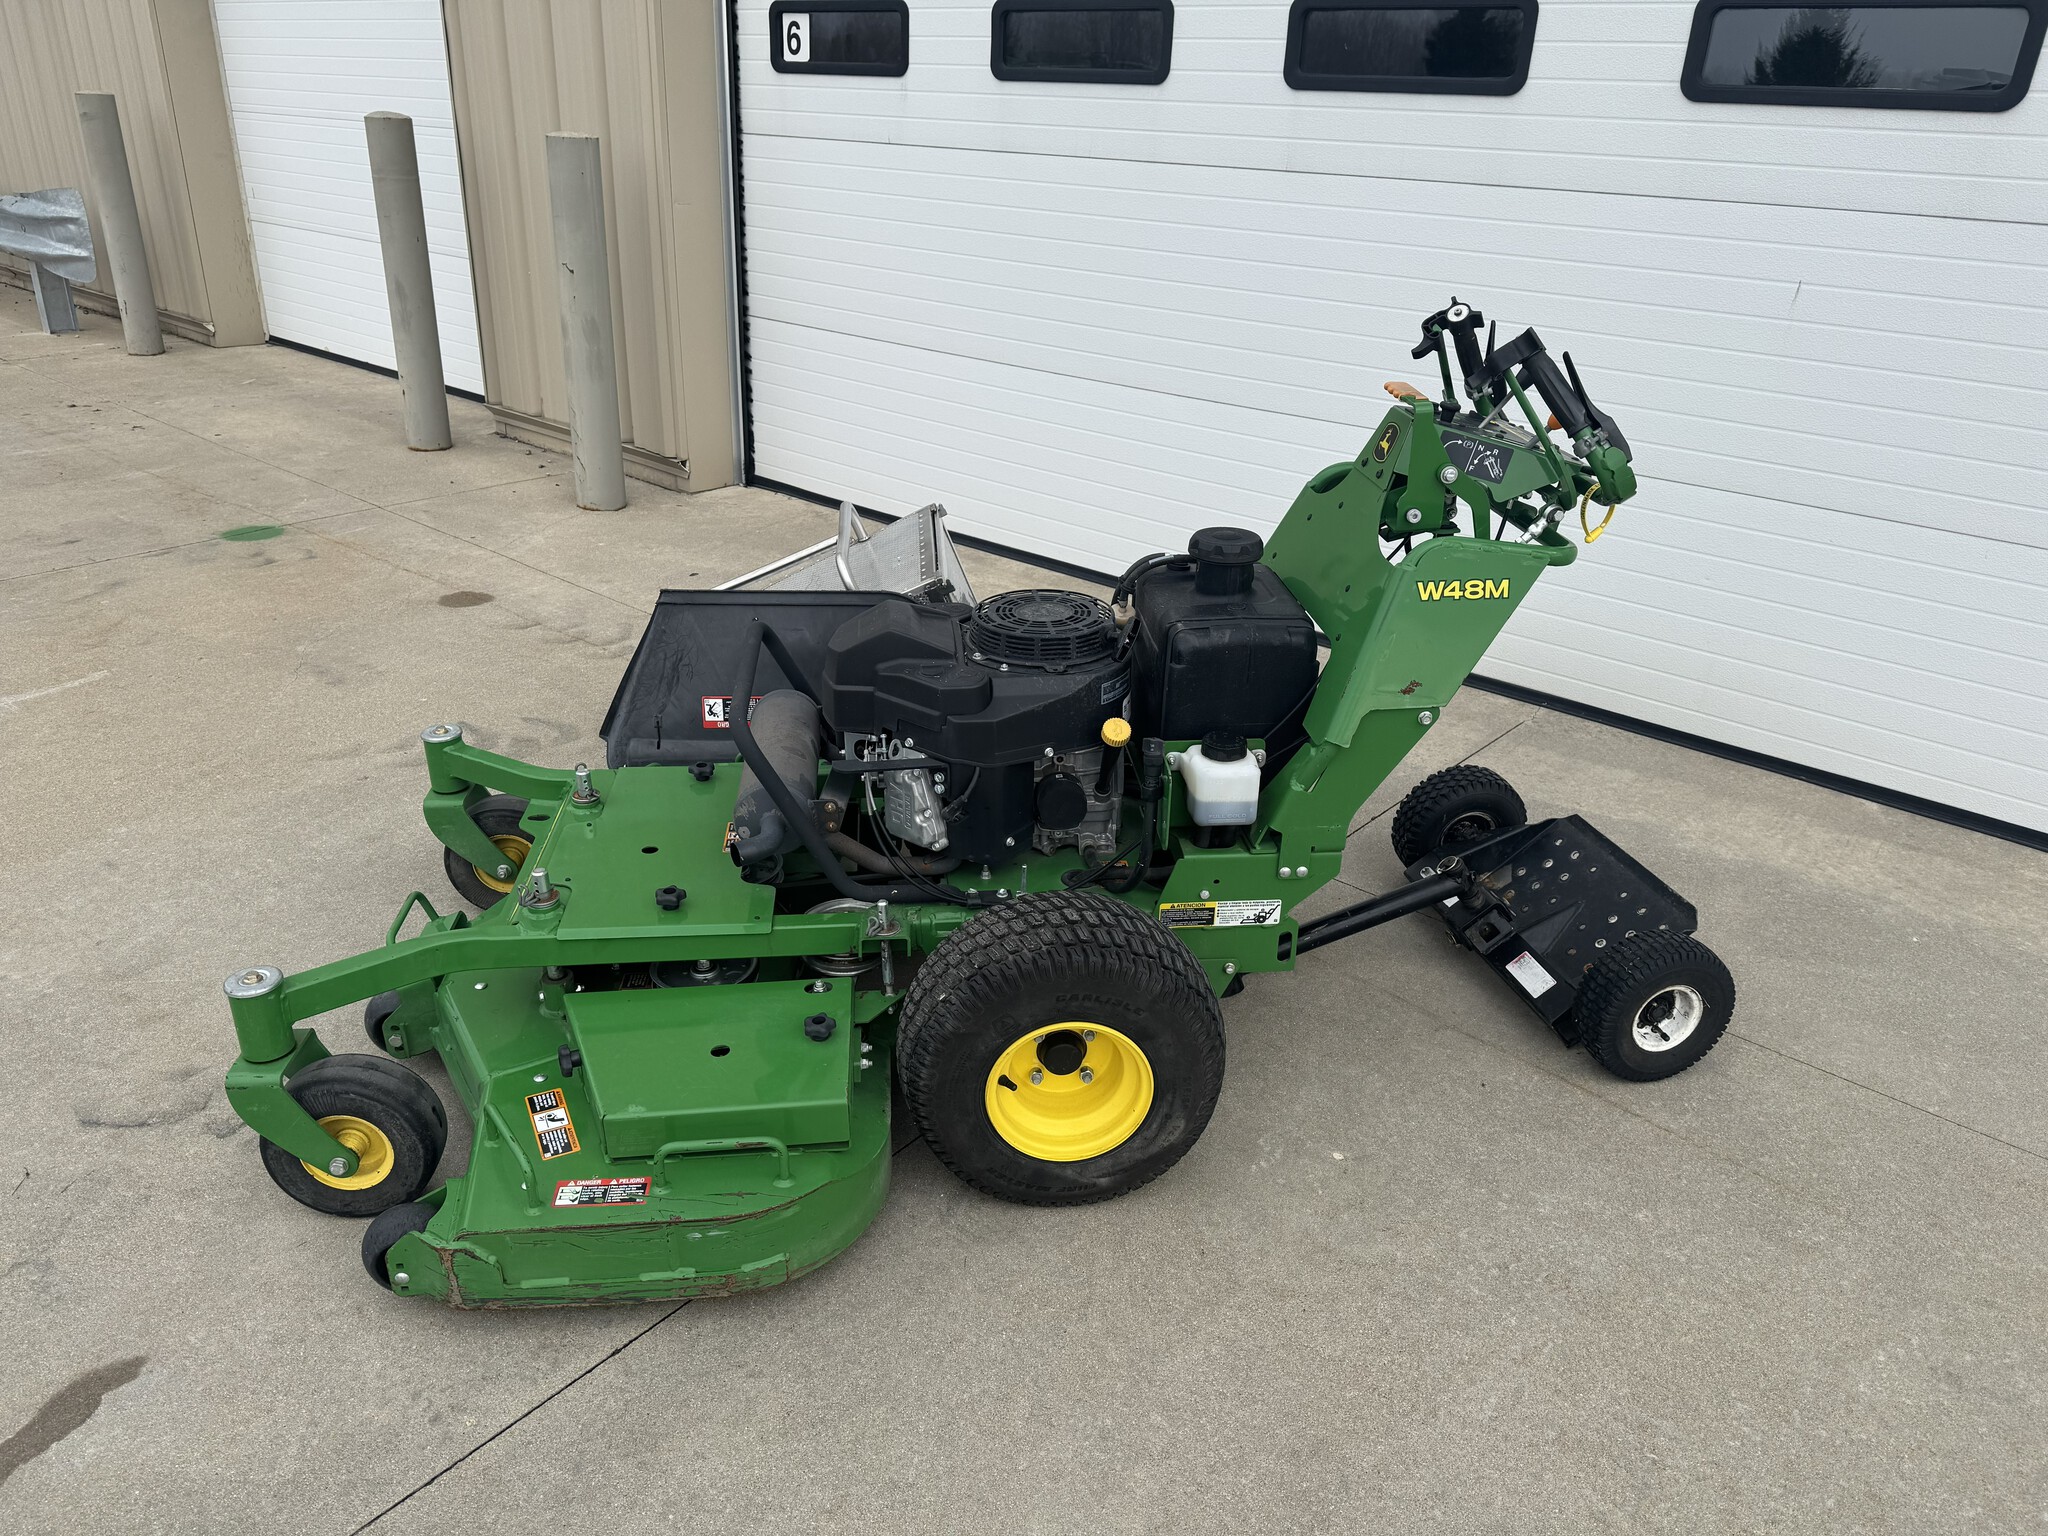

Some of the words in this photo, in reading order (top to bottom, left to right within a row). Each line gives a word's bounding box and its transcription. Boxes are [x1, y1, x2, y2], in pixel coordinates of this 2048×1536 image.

[787, 20, 801, 55] 6
[1477, 444, 1485, 452] N
[1492, 448, 1499, 456] R
[1416, 578, 1510, 601] W48M
